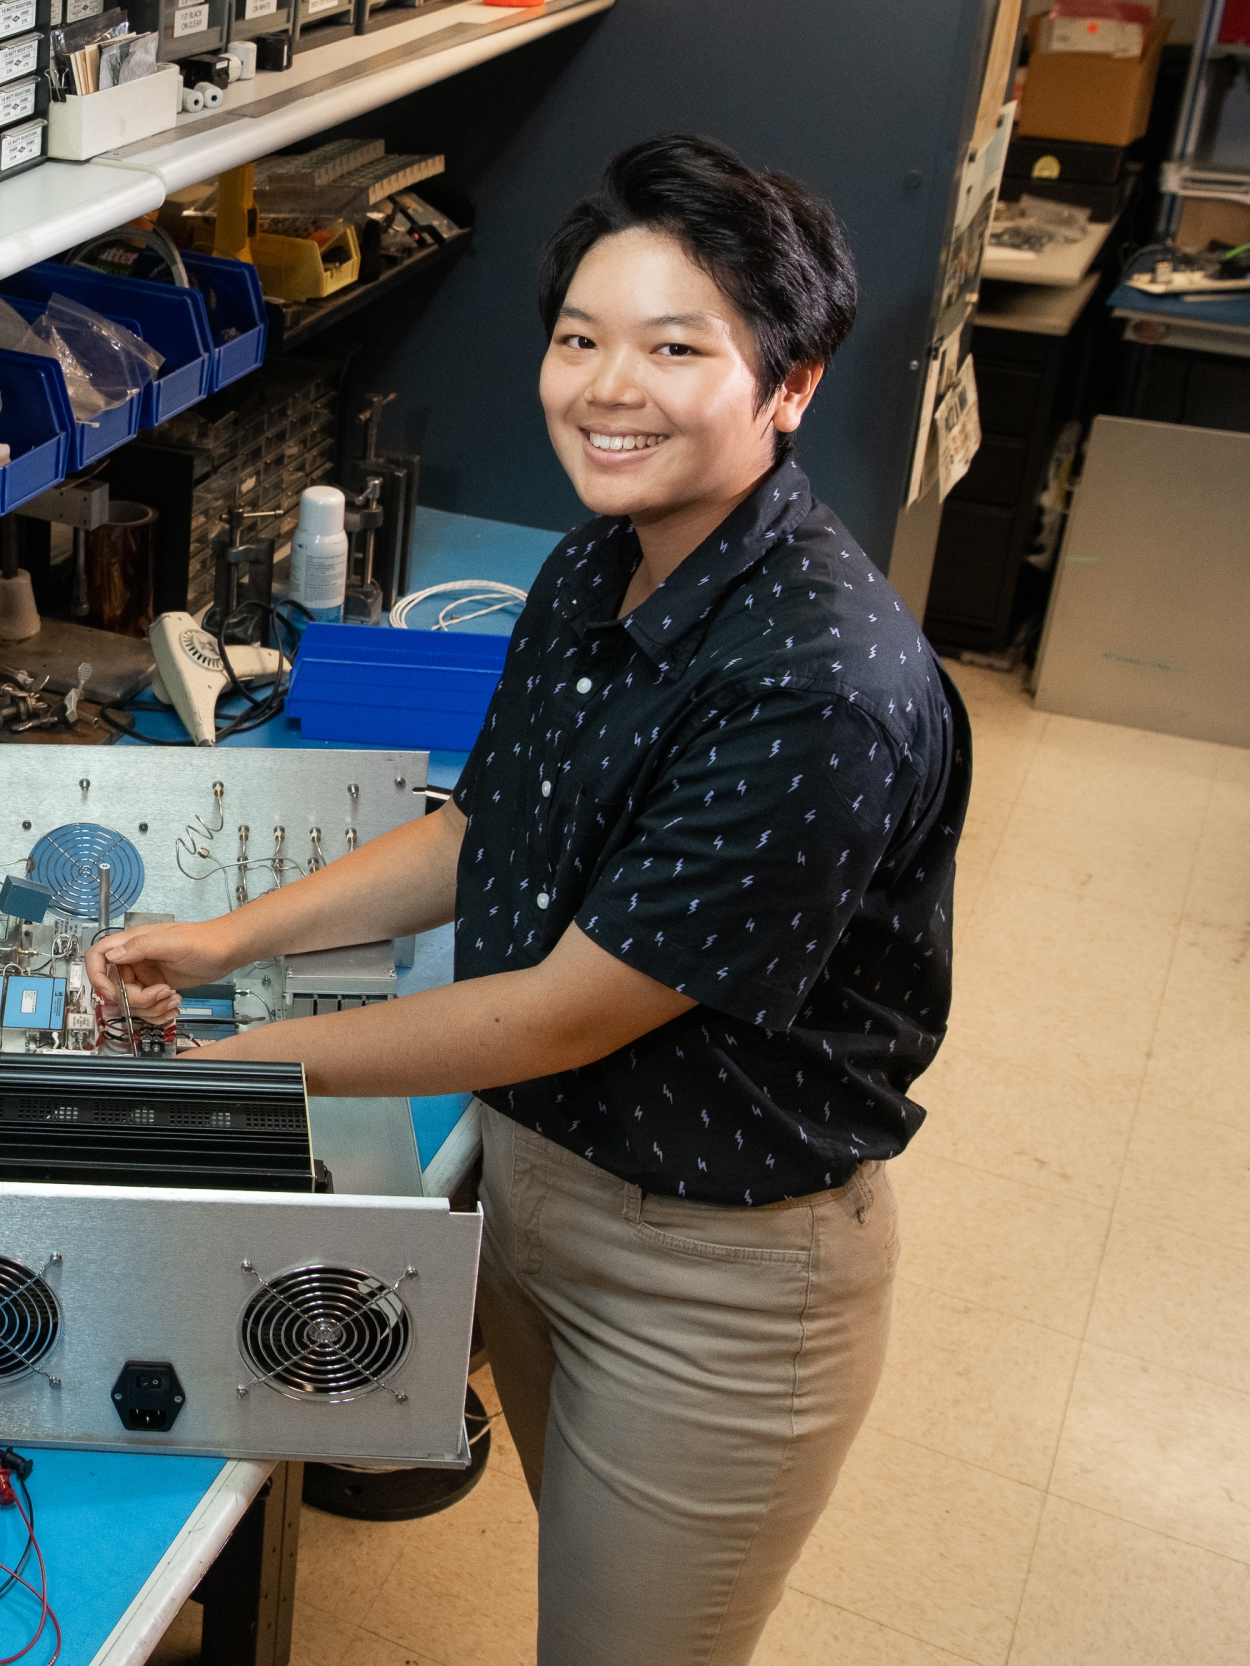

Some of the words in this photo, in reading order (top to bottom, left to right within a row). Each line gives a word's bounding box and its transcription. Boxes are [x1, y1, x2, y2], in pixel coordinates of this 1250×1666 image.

[15, 1, 32, 10] RESISTORS
[259, 2, 271, 11] WHITE
[189, 10, 202, 19] BLACK
[181, 22, 188, 30] ON
[189, 19, 202, 29] CLEAR
[16, 44, 34, 54] RESISTORS
[6, 93, 14, 101] WATT
[14, 88, 31, 97] RESISTORS
[19, 96, 29, 104] OHMS
[12, 137, 20, 145] WATT
[20, 131, 38, 141] RESISTORS
[25, 139, 35, 147] OHMS
